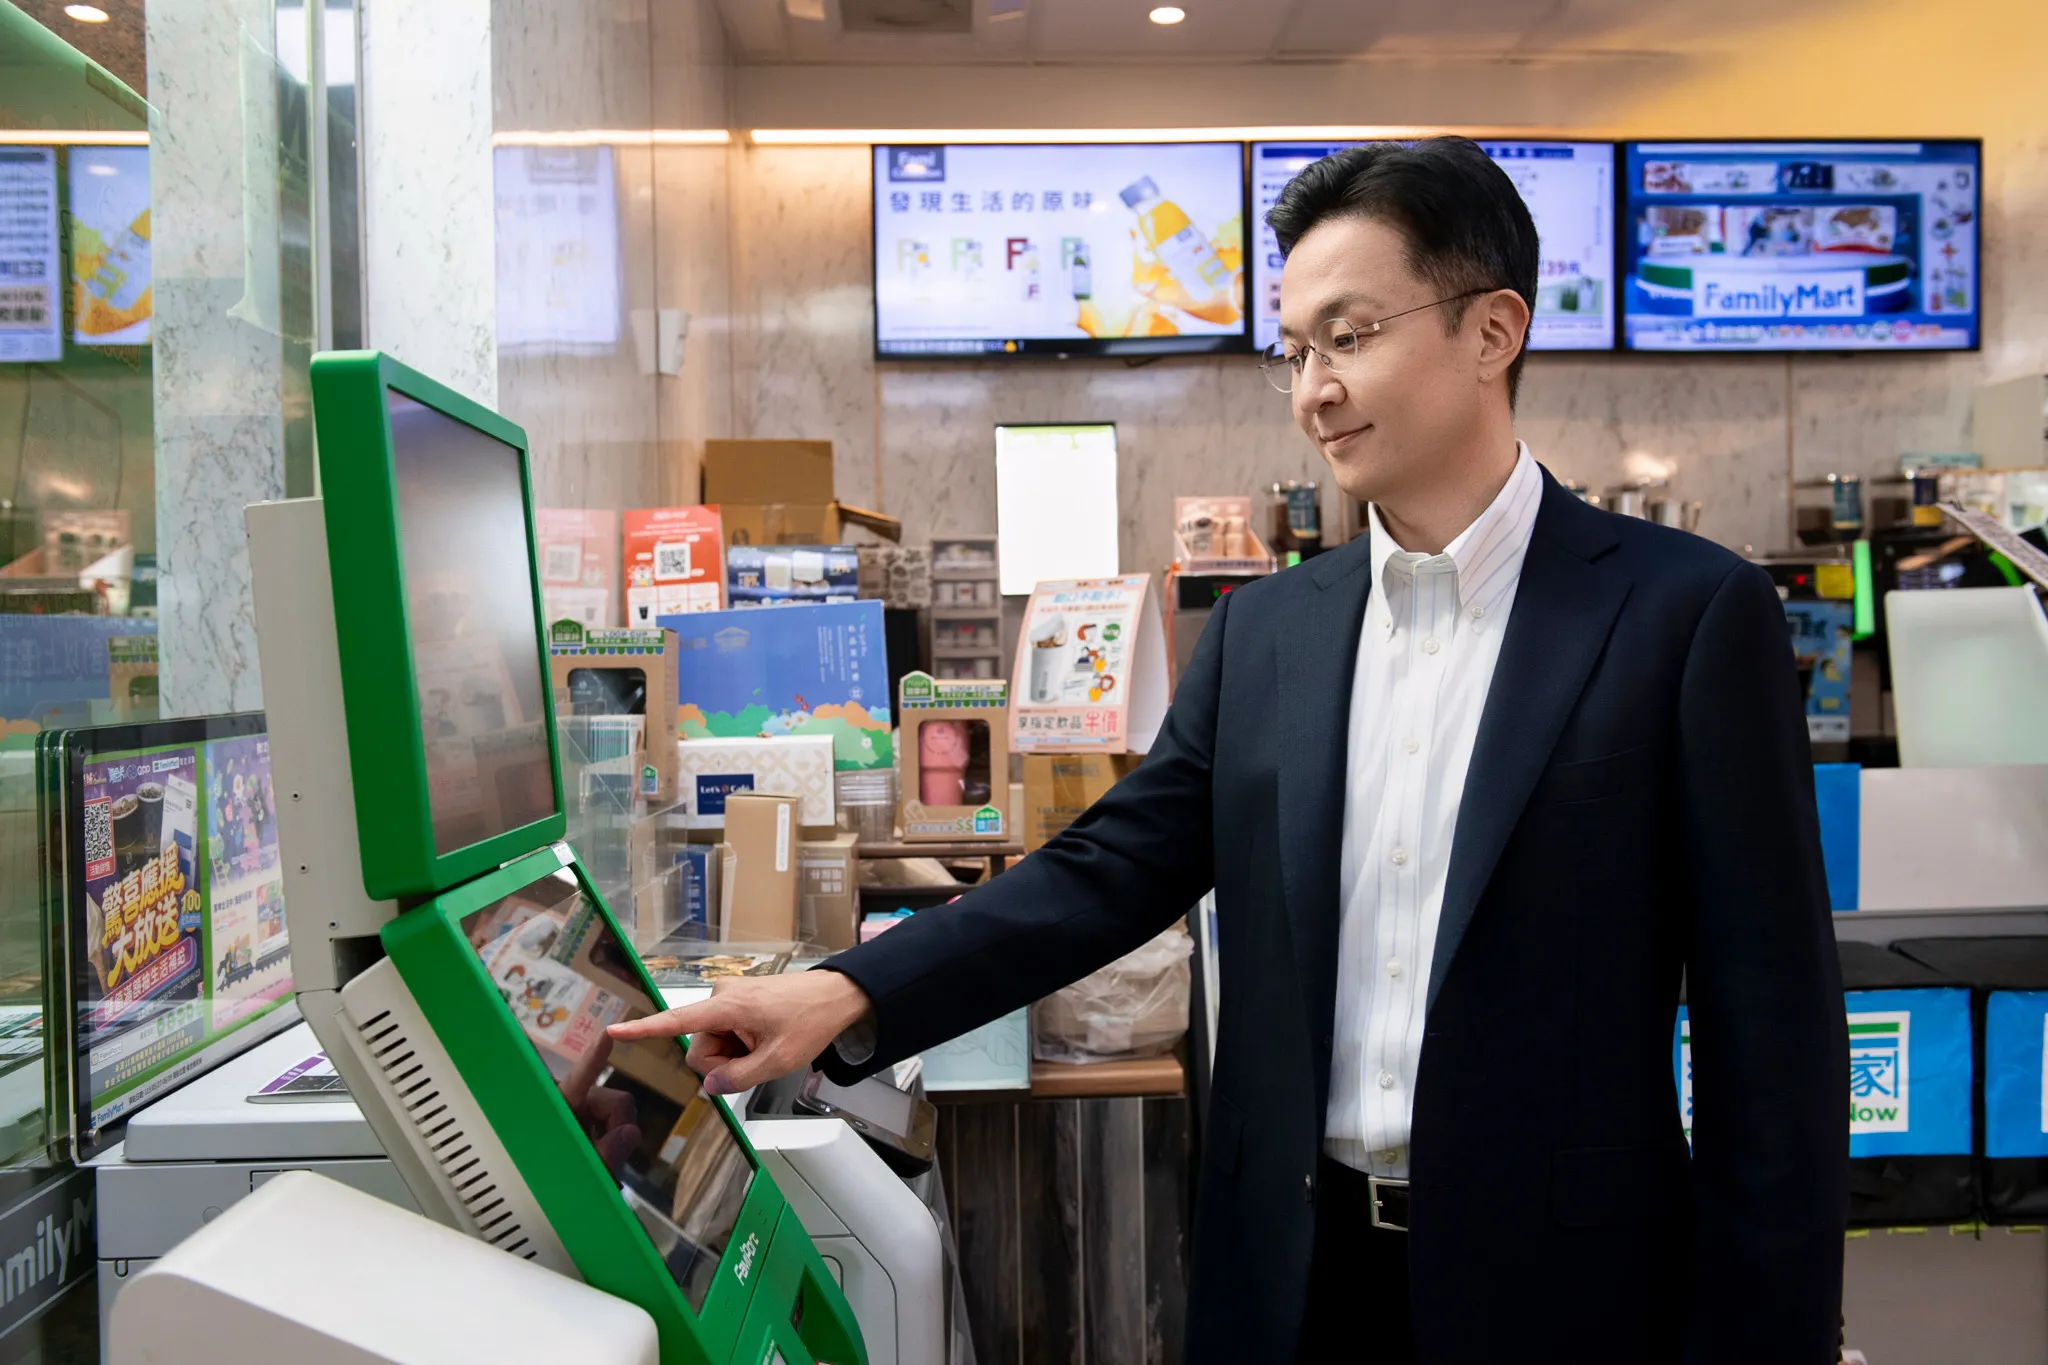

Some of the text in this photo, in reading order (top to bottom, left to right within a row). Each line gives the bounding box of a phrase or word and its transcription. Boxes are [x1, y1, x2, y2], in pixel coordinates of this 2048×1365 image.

[890, 191, 1092, 213] 發現生活的原味
[1704, 282, 1856, 316] FamilyMart
[1084, 709, 1119, 734] 半價
[700, 785, 720, 794] Let's
[107, 892, 181, 989] 大放送
[97, 1101, 125, 1122] FamilyMart
